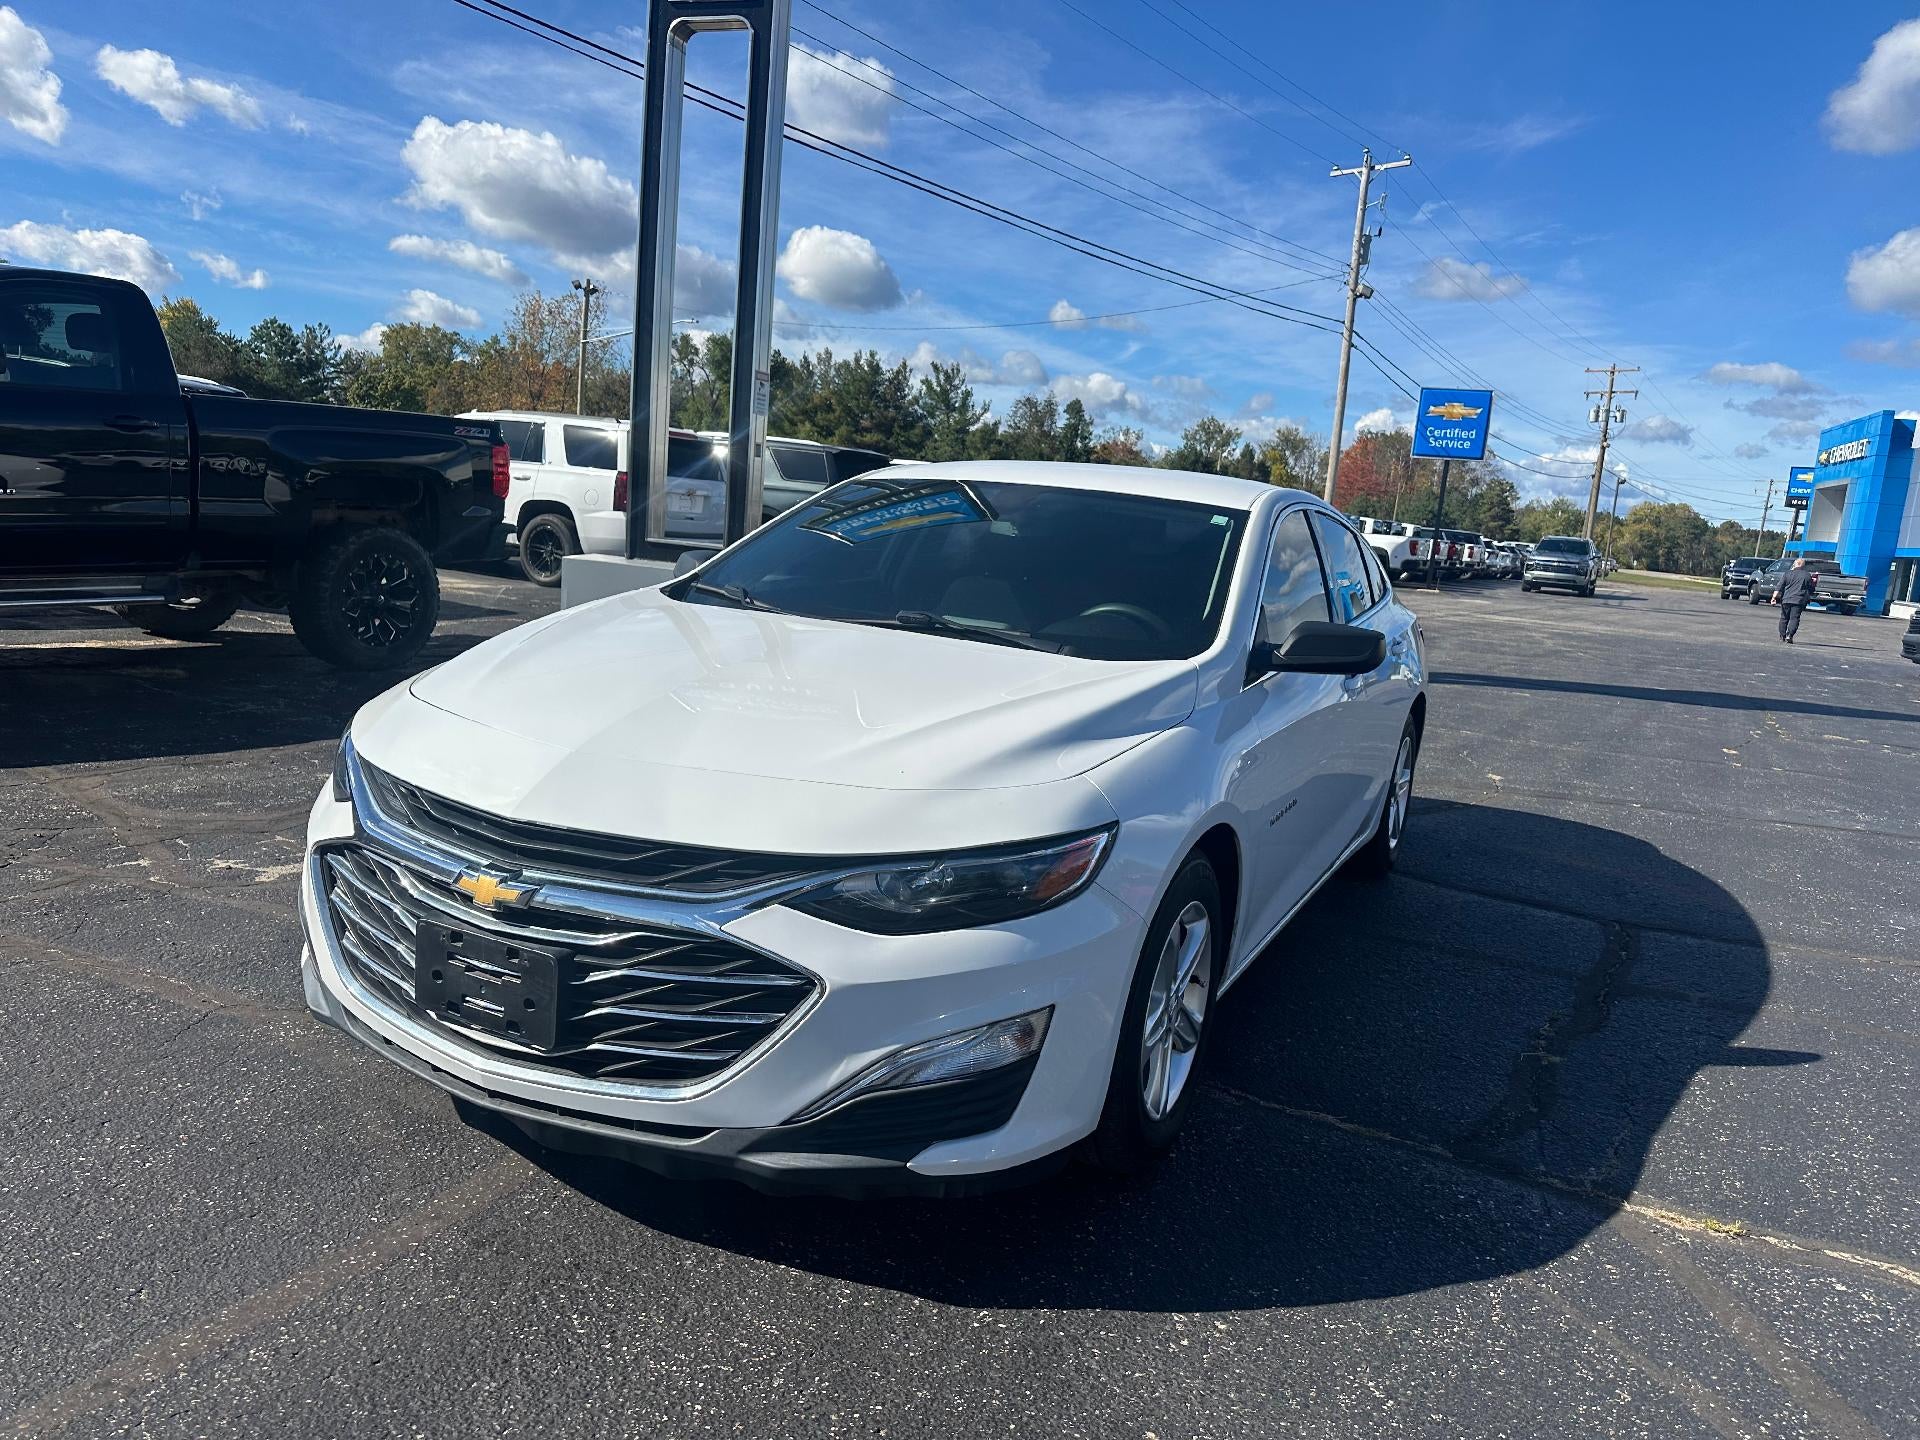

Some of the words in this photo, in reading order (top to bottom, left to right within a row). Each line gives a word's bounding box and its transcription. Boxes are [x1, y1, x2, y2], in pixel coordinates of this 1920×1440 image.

[1426, 427, 1476, 439] Certified
[1428, 437, 1471, 449] Service
[1829, 439, 1869, 463] CHEVROLET
